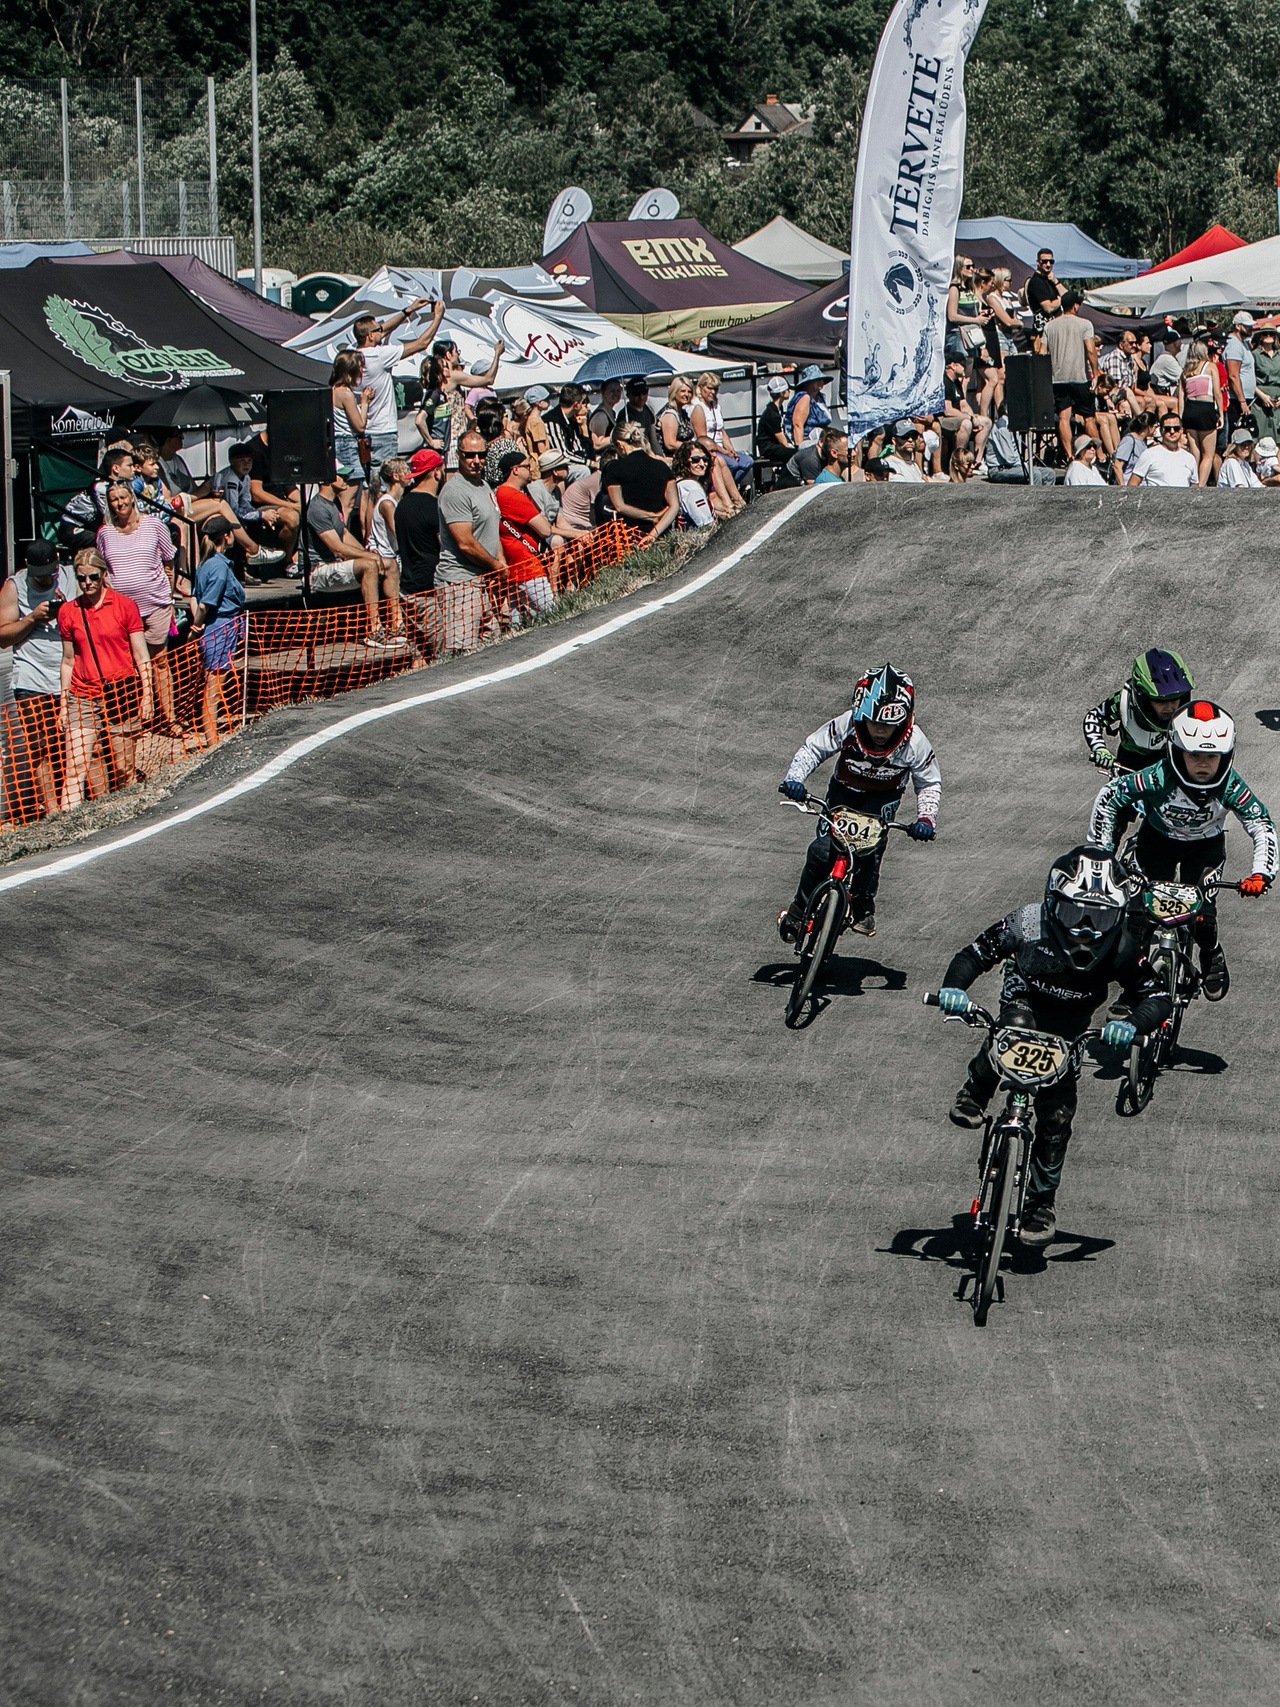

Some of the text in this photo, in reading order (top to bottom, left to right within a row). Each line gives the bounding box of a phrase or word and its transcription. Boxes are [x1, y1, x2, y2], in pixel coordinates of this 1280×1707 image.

[889, 53, 942, 236] TĒRVETE
[922, 67, 955, 237] DABĪGAIS MINERĀLŪDENS
[621, 237, 717, 267] BMX
[643, 264, 729, 281] TUKUMS
[836, 818, 870, 840] 204
[1159, 899, 1183, 914] 525
[1013, 1045, 1056, 1073] 325
